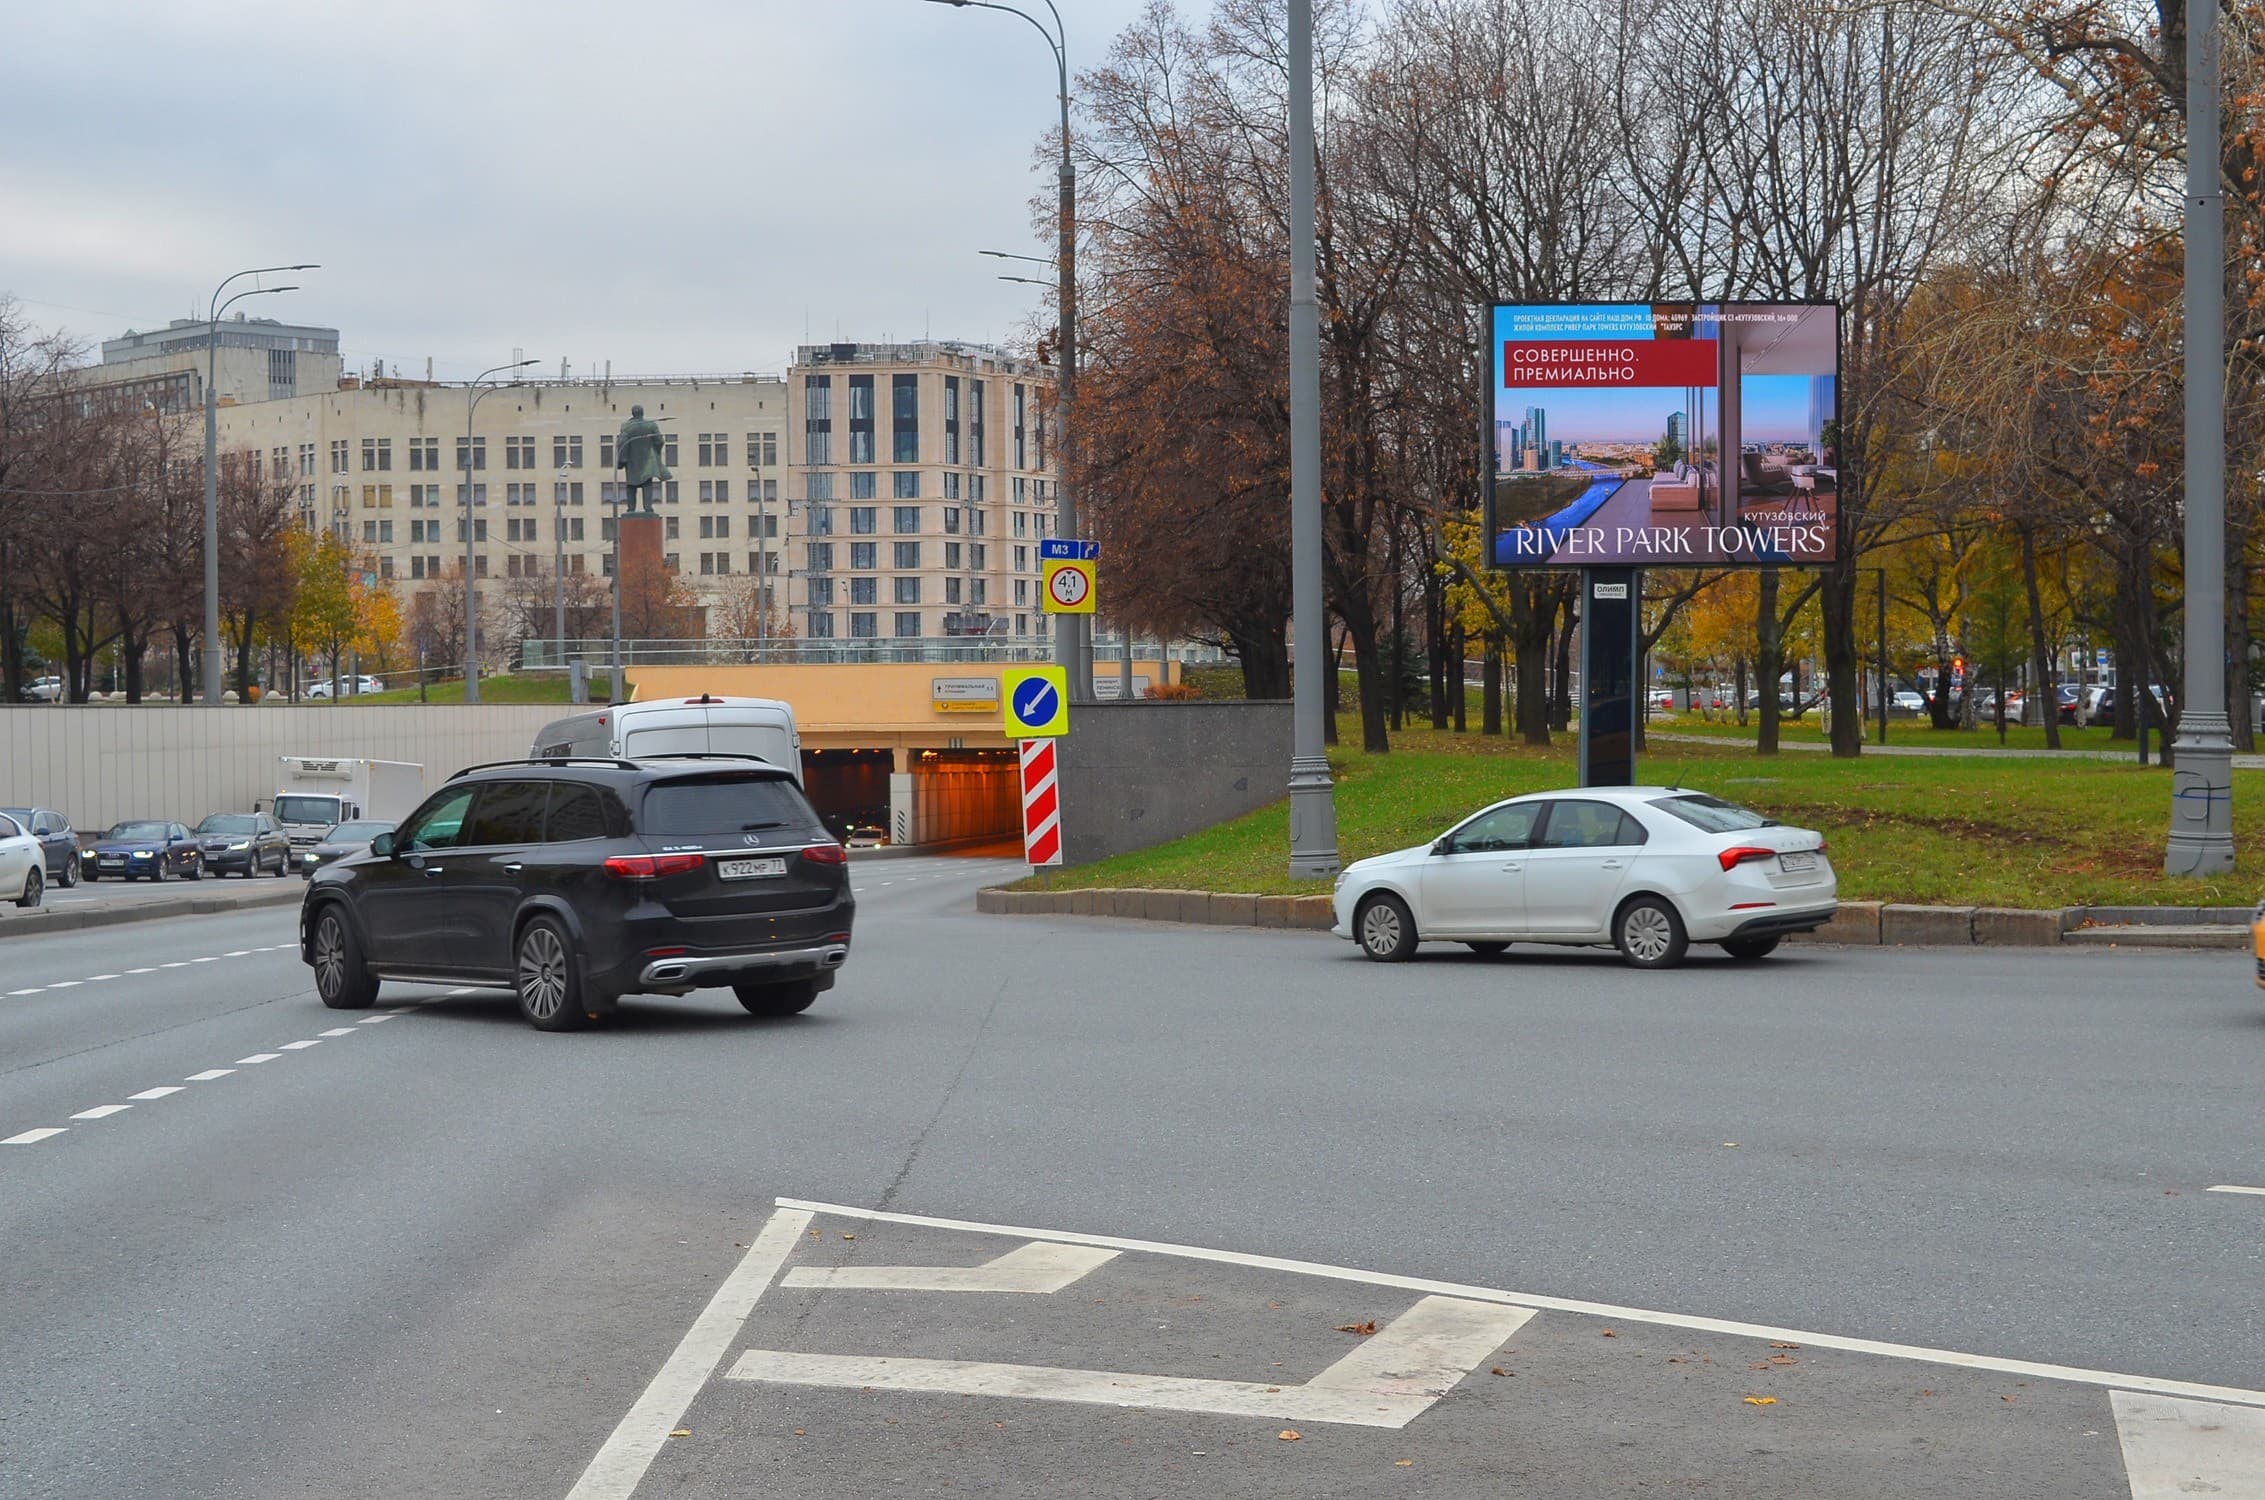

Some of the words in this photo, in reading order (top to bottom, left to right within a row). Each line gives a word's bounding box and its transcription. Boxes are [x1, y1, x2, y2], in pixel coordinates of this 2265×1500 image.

[1513, 348, 1640, 363] СОВЕРШЕННО.
[1513, 367, 1635, 381] ПРЕМИАЛЬНО
[1744, 510, 1826, 522] КУТУЗОВСКИЙ
[1503, 527, 1606, 555] RIVER
[1615, 527, 1693, 554] PARK
[1701, 525, 1826, 553] TOWERS
[1597, 585, 1625, 593] ОЛИМП
